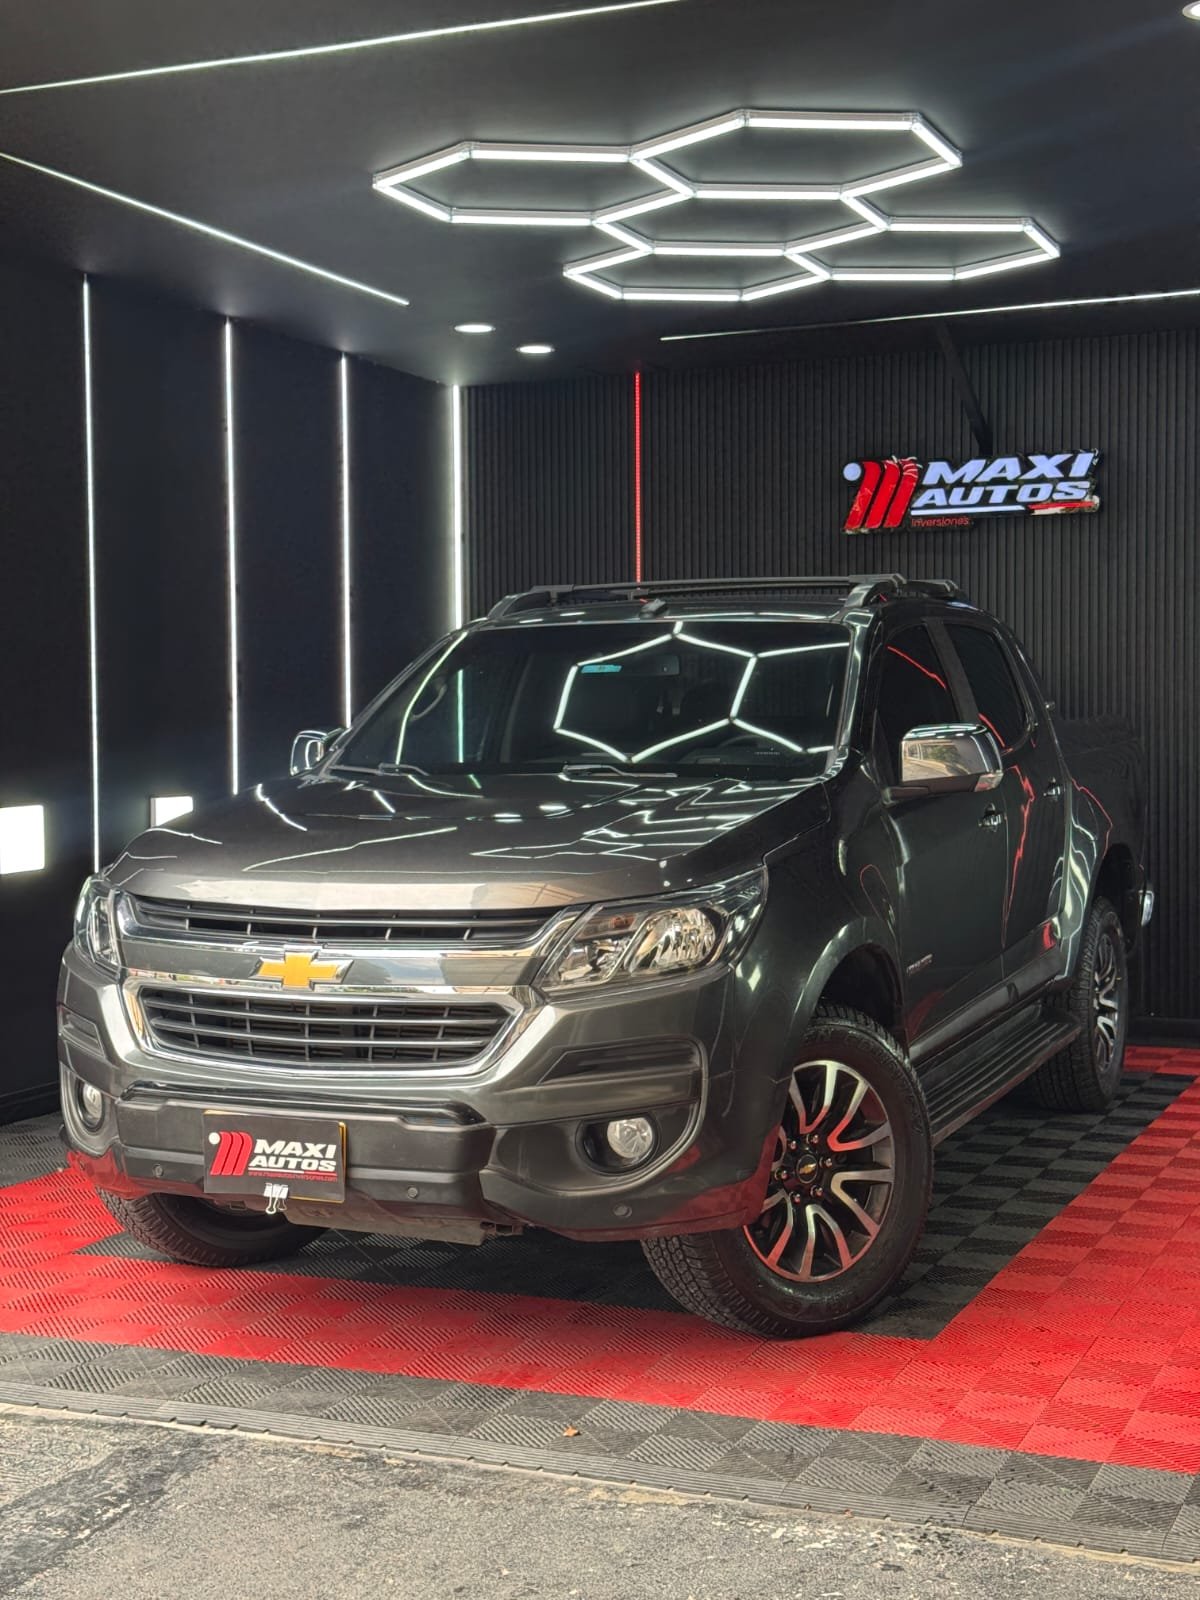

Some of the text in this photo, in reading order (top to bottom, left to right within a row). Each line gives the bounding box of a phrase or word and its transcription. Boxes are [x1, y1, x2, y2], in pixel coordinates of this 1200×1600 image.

[922, 452, 1094, 485] MAXI
[911, 481, 1091, 508] AUTOS
[254, 1139, 337, 1159] MAXI
[248, 1155, 337, 1172] AUTOS
